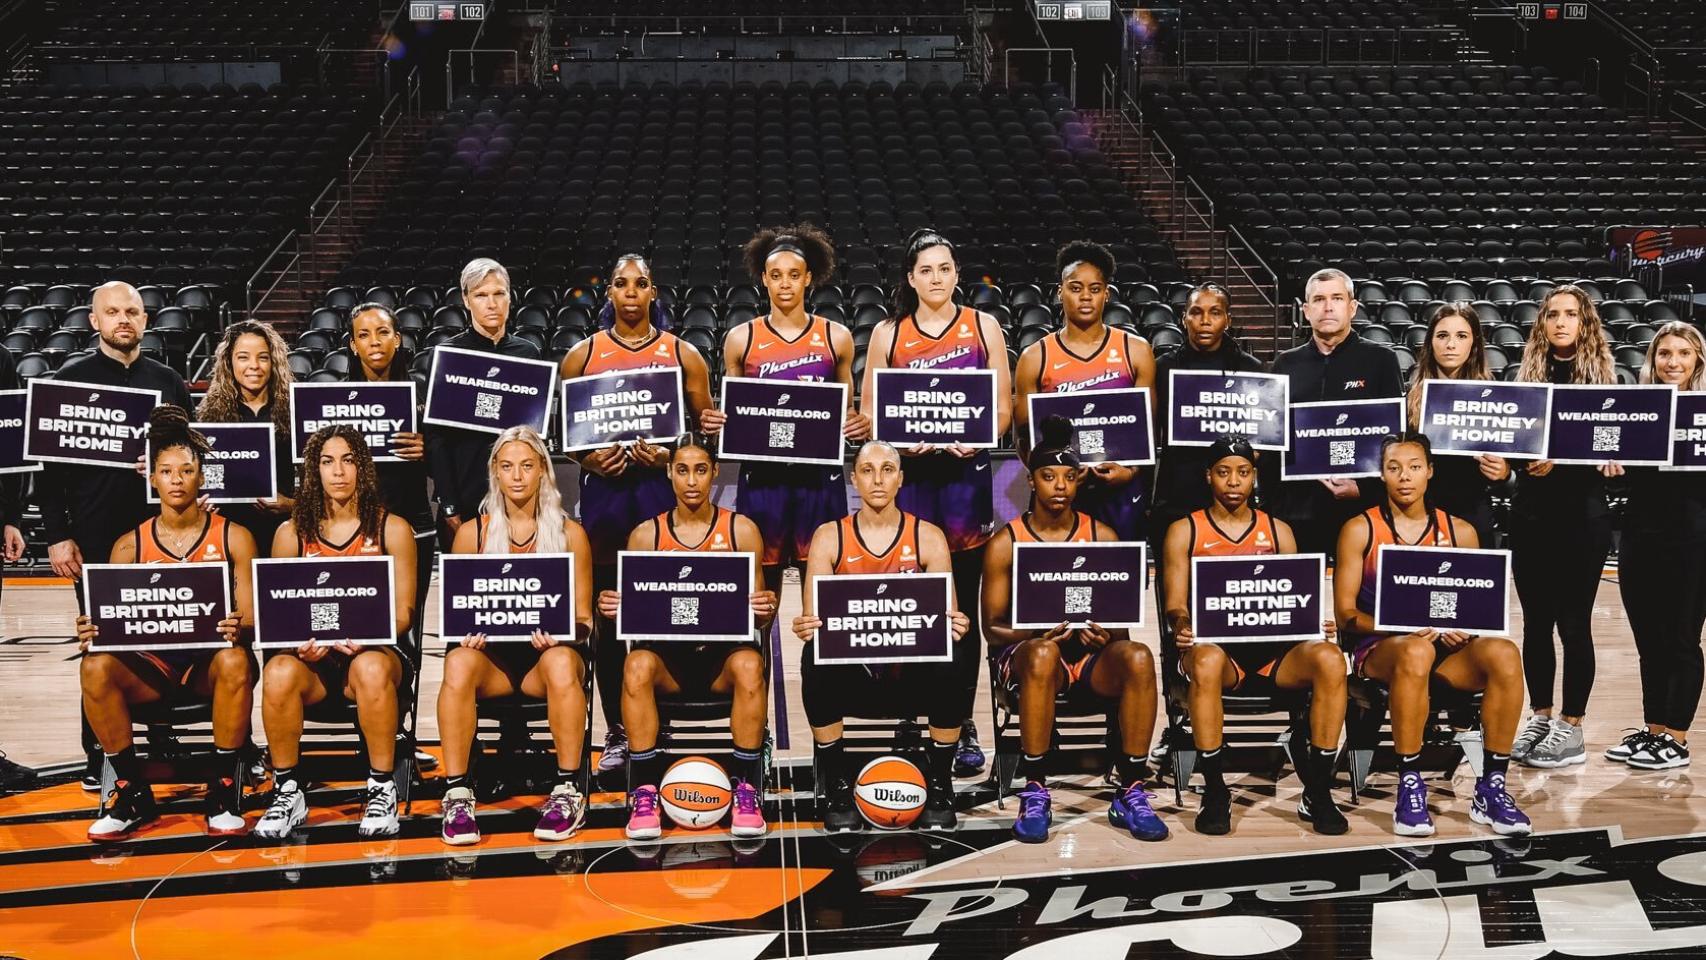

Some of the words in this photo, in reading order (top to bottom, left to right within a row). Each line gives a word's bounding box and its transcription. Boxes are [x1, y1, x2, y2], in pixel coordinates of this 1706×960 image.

[415, 6, 430, 18] 101
[464, 6, 481, 18] 102
[1041, 6, 1057, 18] 102
[1091, 6, 1106, 18] 103
[1521, 5, 1536, 17] 103
[1568, 5, 1584, 17] 104
[1632, 247, 1706, 267] Mrcury
[759, 352, 823, 378] Phoenix
[444, 374, 539, 395] WEAREBG.ORG
[1344, 380, 1365, 390] PHX
[590, 389, 653, 407] BRING
[903, 391, 966, 405] BRING
[1199, 391, 1260, 407] BRING
[59, 403, 127, 422] BRING
[322, 403, 386, 418] BRING
[573, 402, 671, 424] BRITTNEY
[735, 406, 831, 420] WEAREBG.ORG
[885, 405, 985, 419] BRITTNEY
[1180, 404, 1279, 423] BRITTNEY
[1452, 400, 1519, 415] BRING
[1070, 414, 1137, 427] REBG.ORG
[1432, 413, 1538, 430] BRITTNEY
[1557, 411, 1659, 422] WEAREBG.ORG
[38, 417, 145, 440] BRITTNEY
[593, 418, 653, 435] HOME
[905, 420, 965, 434] HOME
[1200, 420, 1259, 436] HOME
[1294, 424, 1391, 438] WEAREBG.ORG
[59, 434, 123, 453] HOME
[1451, 428, 1515, 444] HOME
[1028, 571, 1130, 582] WEAREBG.ORG
[1393, 574, 1495, 589] WEAREBG.ORG
[269, 586, 378, 600] WEAREBG.ORG
[472, 577, 542, 593] BRING
[633, 581, 738, 593] WEAREBG.ORG
[1225, 578, 1293, 594] BRING
[120, 587, 194, 604] BRING
[452, 594, 562, 609] BRITTNEY
[1205, 594, 1312, 611] BRITTNEY
[99, 603, 216, 620] BRITTNEY
[847, 598, 918, 614] BRING
[474, 610, 540, 626] HOME
[827, 614, 939, 631] BRITTNEY
[1227, 611, 1292, 627] HOME
[124, 619, 195, 636] HOME
[850, 632, 917, 648] HOME
[673, 788, 720, 804] Wilson
[873, 787, 920, 803] Wilson
[901, 849, 1607, 936] Phoenix
